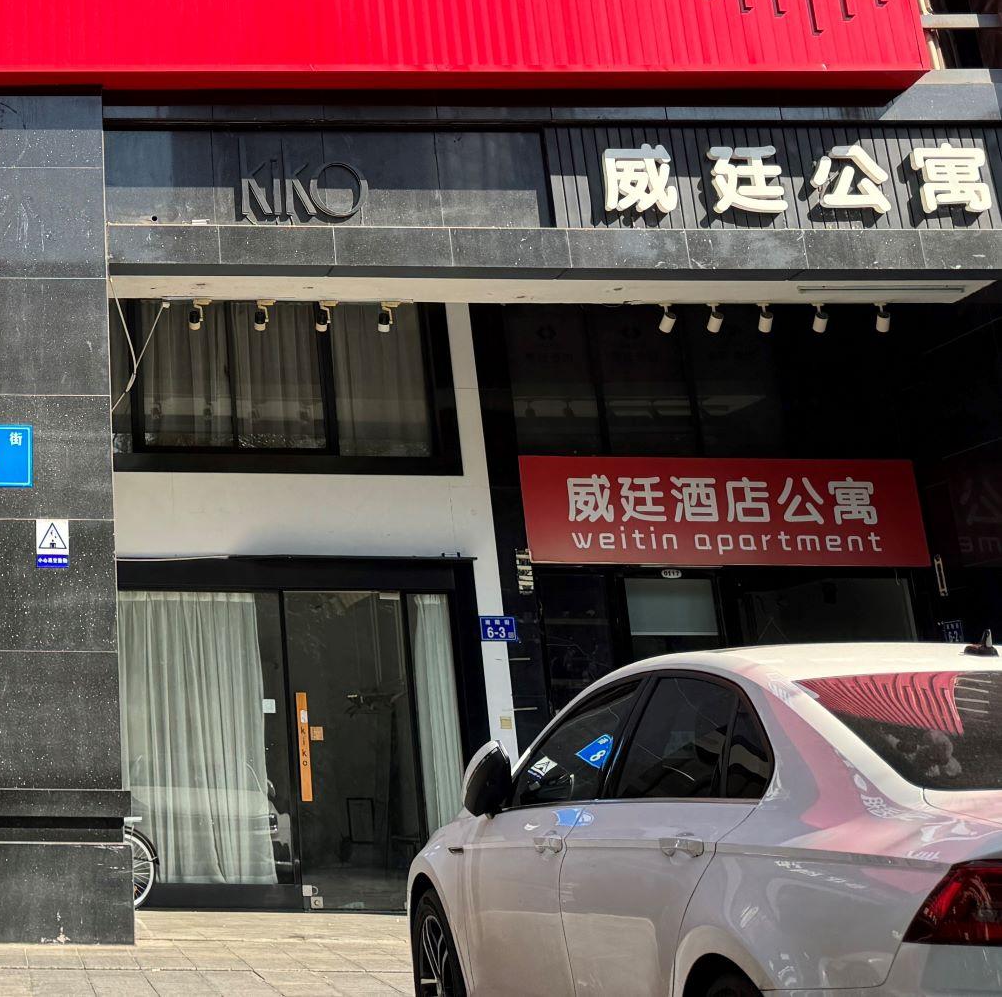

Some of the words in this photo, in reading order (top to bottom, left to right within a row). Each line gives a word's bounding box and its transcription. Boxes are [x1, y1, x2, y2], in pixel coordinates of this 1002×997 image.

[602, 143, 992, 214] 威廷公寓
[566, 474, 879, 525] 威廷酒店公寓
[571, 525, 678, 550] weitin
[694, 530, 883, 554] apartment
[487, 627, 506, 638] 6-3
